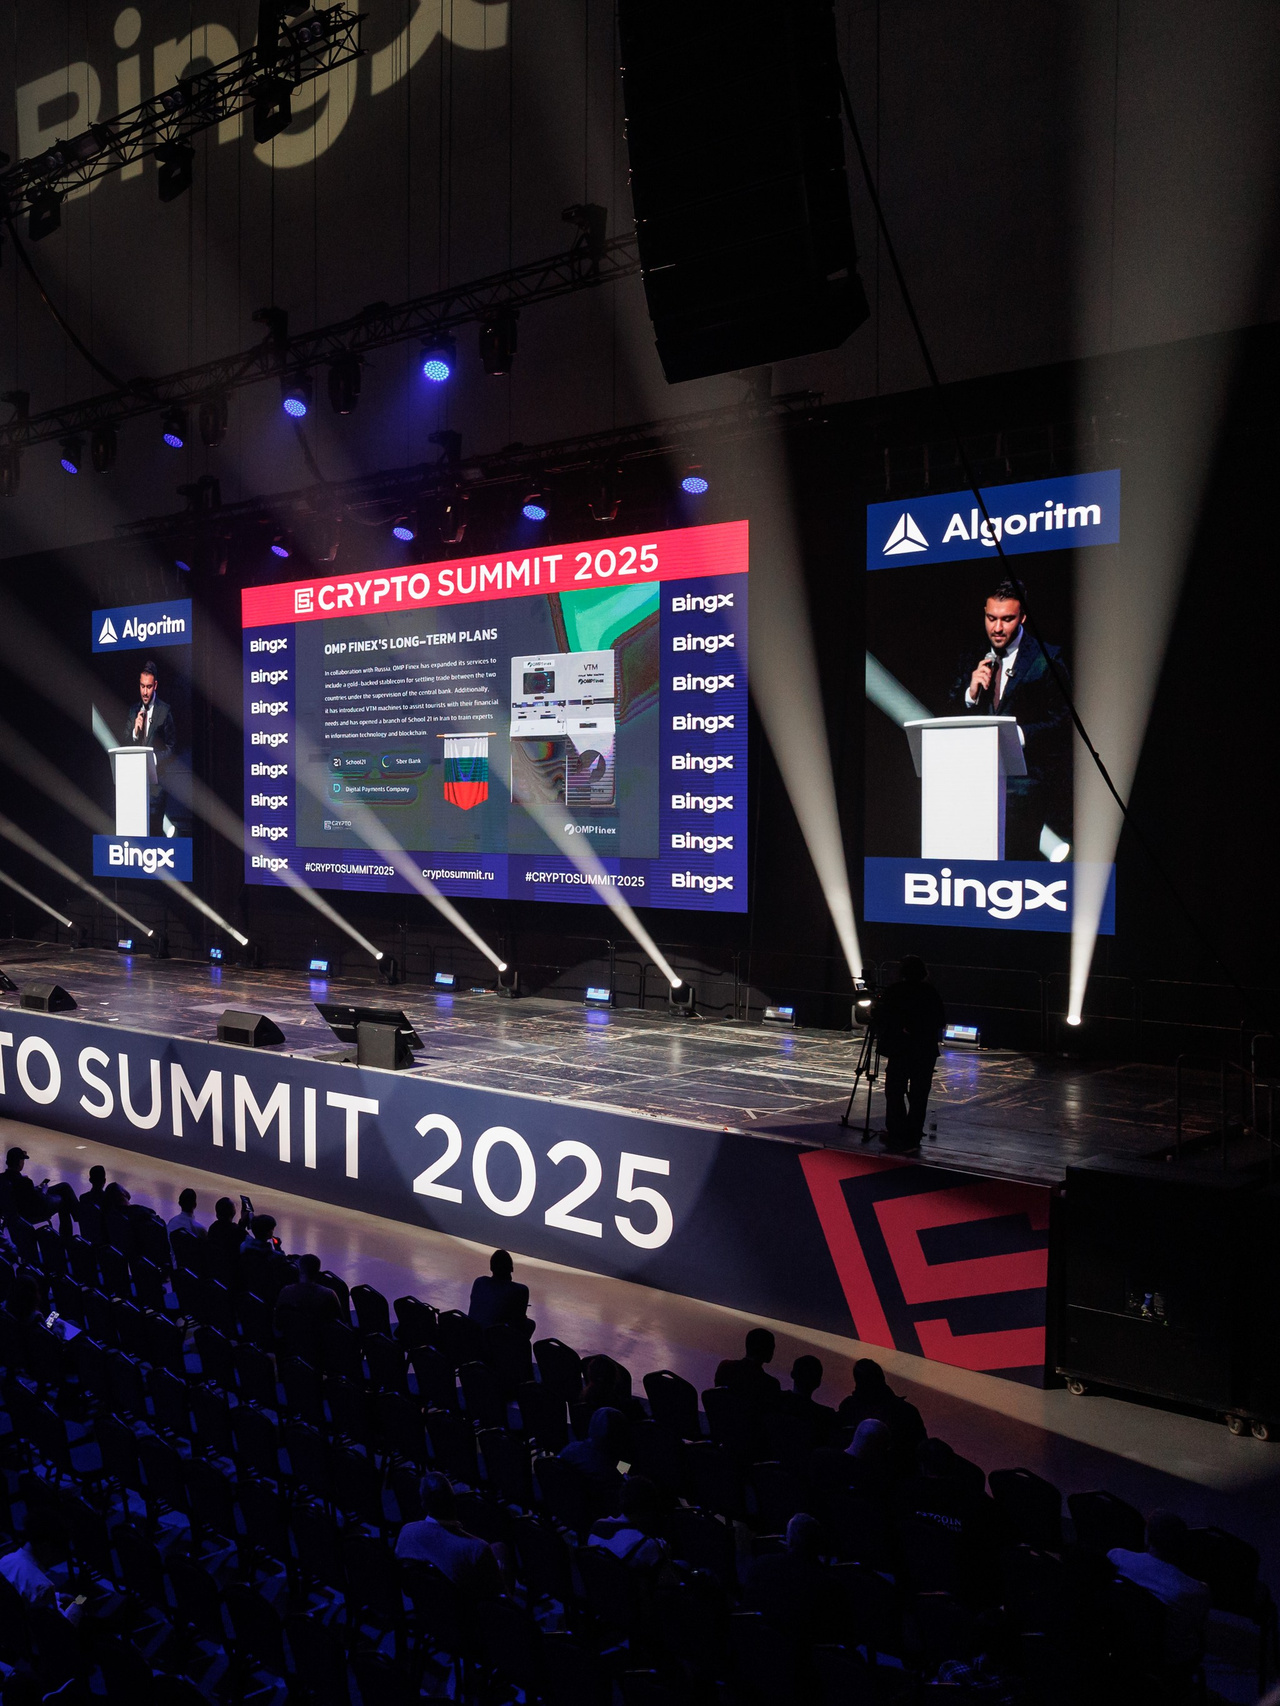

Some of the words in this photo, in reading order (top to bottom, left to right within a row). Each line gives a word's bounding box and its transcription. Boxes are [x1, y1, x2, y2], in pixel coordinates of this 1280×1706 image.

[941, 500, 1101, 547] Algoritm
[318, 572, 431, 610] CRYPTO
[437, 554, 563, 597] SUMMIT
[574, 543, 660, 581] 2025
[122, 614, 185, 642] Algoritm
[324, 643, 347, 655] OMP
[348, 638, 388, 653] FINEX'S
[458, 628, 498, 642] PLANS
[330, 668, 362, 676] collaboration
[431, 660, 457, 669] expanded
[584, 663, 598, 671] VTM
[347, 680, 378, 689] gold-backed
[472, 713, 494, 721] experts
[345, 758, 367, 766] School21
[345, 786, 361, 794] Digital
[305, 862, 395, 876] #CRYPTOSUMMIT2025
[422, 868, 495, 881] cryptosummit.ru
[525, 871, 645, 888] #CRYPTOSUMMIT2025
[78, 1046, 380, 1179] SUMMIT
[413, 1113, 674, 1250] 2025
